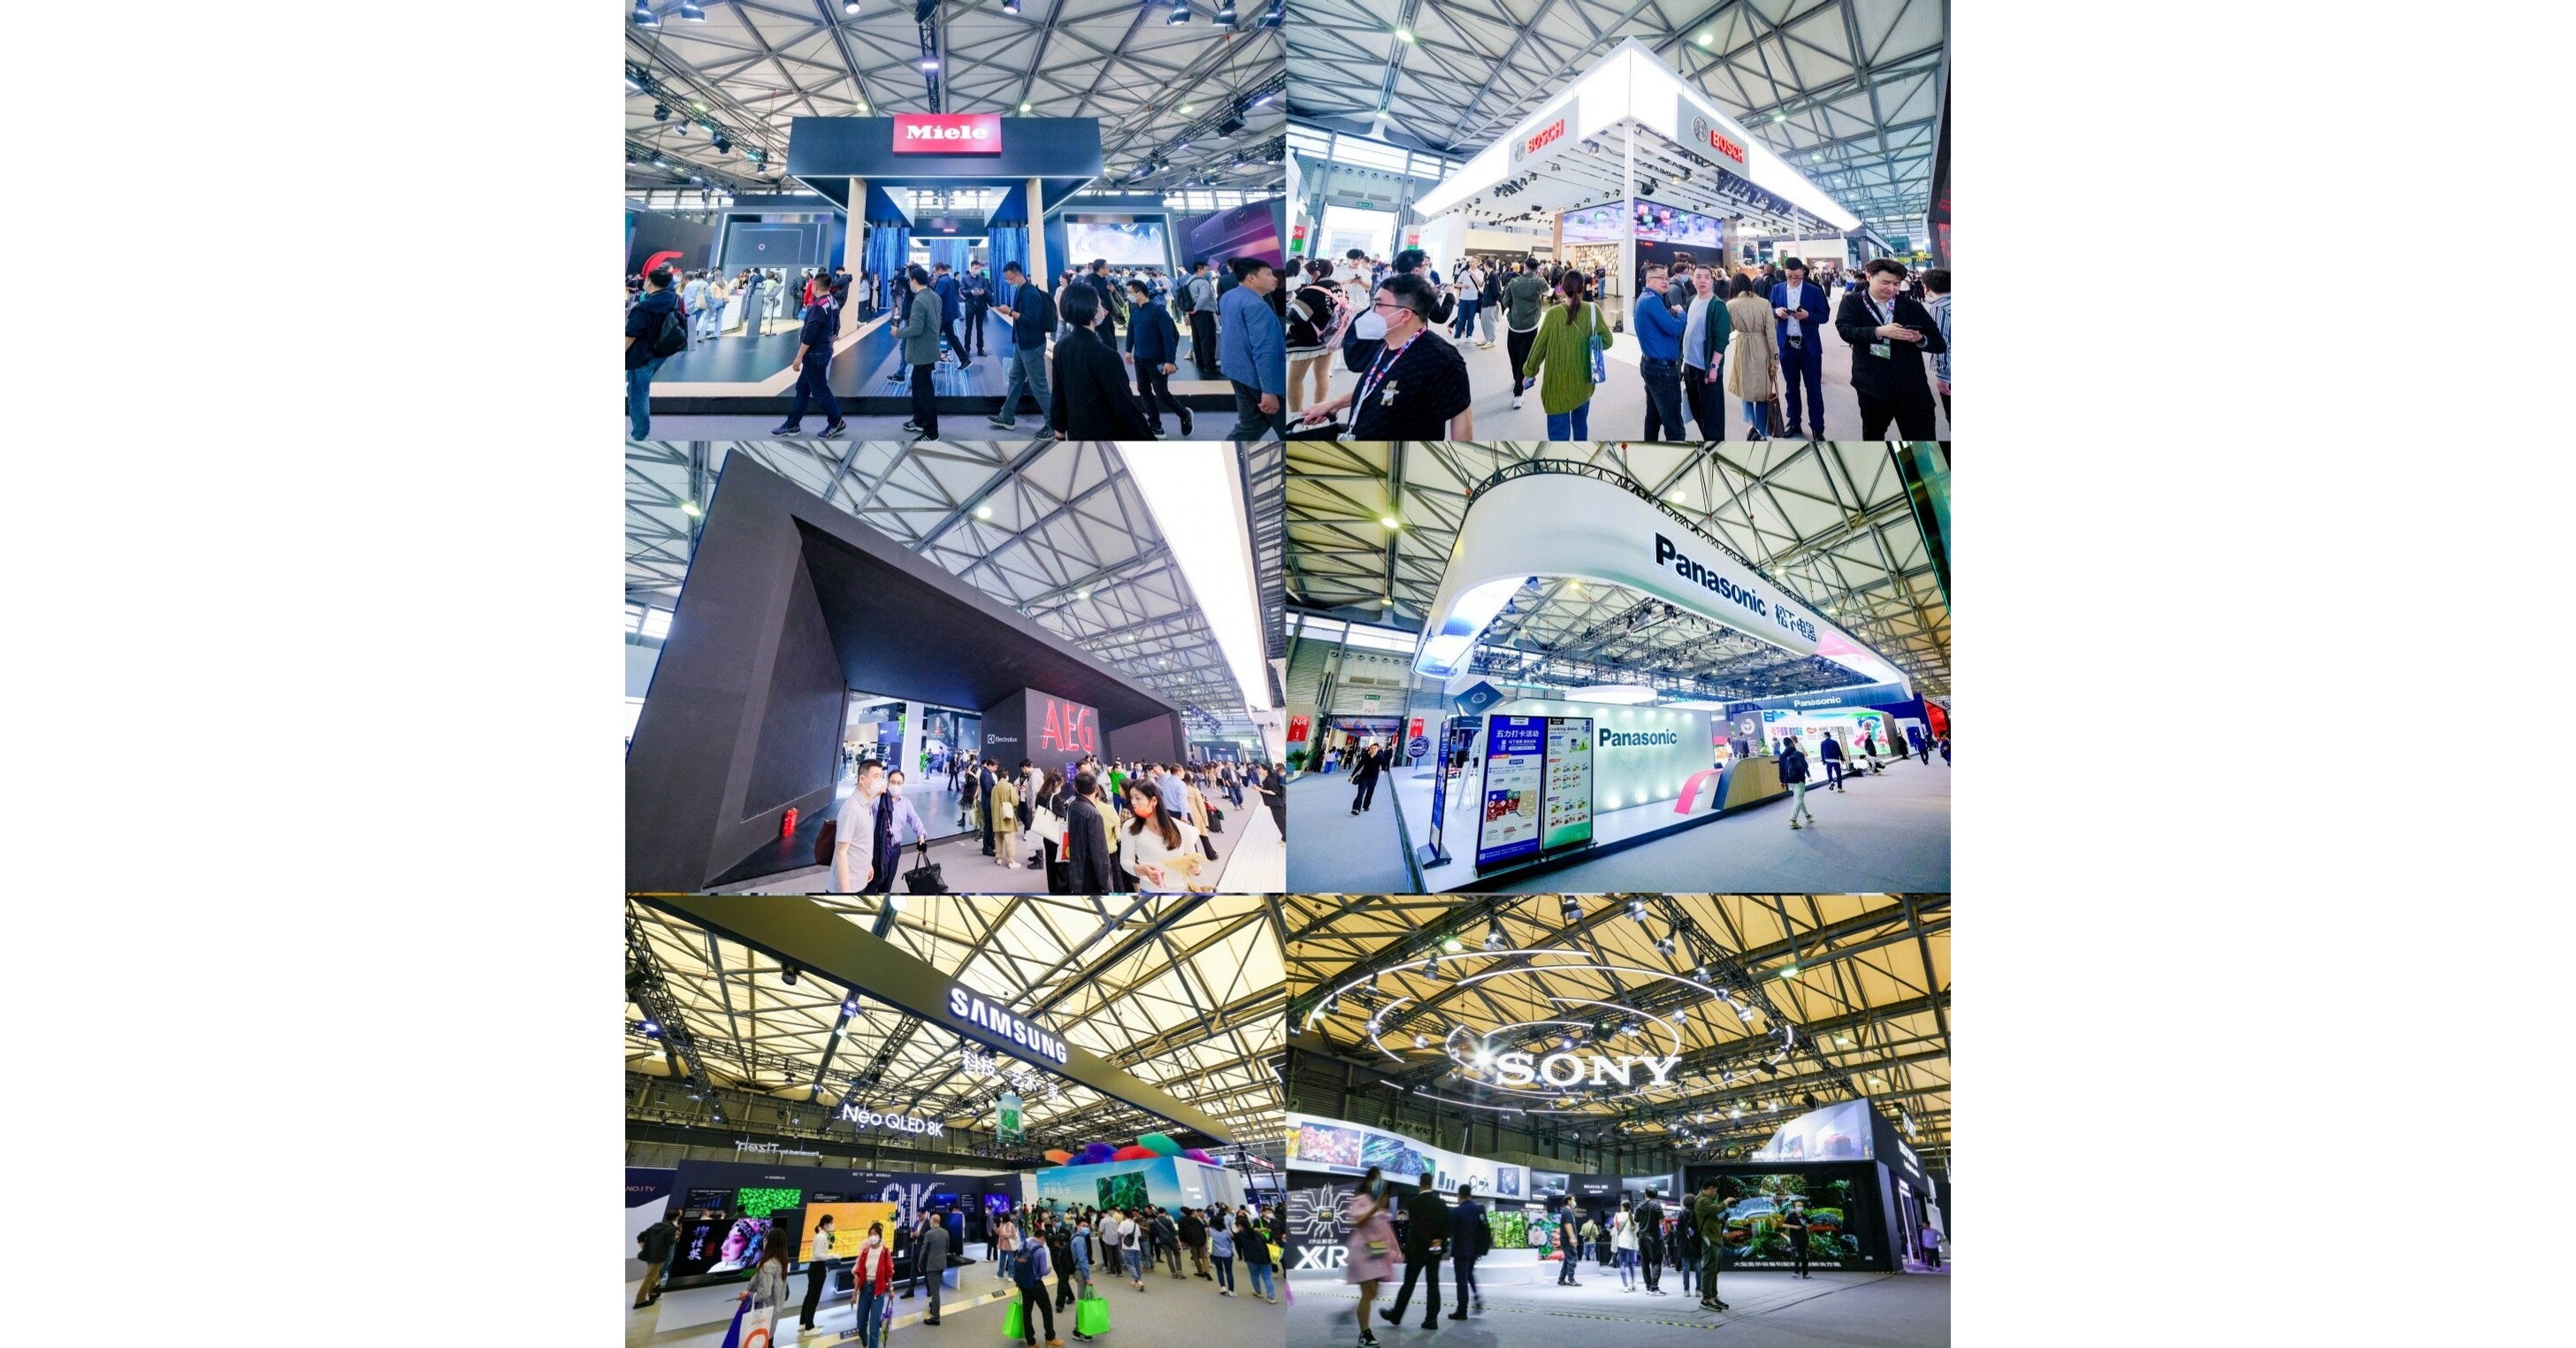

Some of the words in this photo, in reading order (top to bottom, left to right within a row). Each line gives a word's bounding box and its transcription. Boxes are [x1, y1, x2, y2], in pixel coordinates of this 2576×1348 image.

[906, 125, 988, 140] Miele
[1527, 119, 1564, 154] BOSCH
[1710, 129, 1745, 163] BOSCH
[1655, 532, 1767, 617] Panasonic
[1774, 603, 1817, 642] 松下电器
[1793, 696, 1842, 708] Panasonic
[1041, 699, 1095, 754] AEG
[1292, 717, 1308, 726] N4
[1599, 728, 1678, 747] Panasonic
[951, 988, 1067, 1063] SAMSUNG
[1496, 1053, 1682, 1086] SONY
[842, 1104, 883, 1126] Neo
[885, 1113, 926, 1134] QLED
[928, 1122, 944, 1137] 8K
[1295, 1245, 1349, 1270] XR
